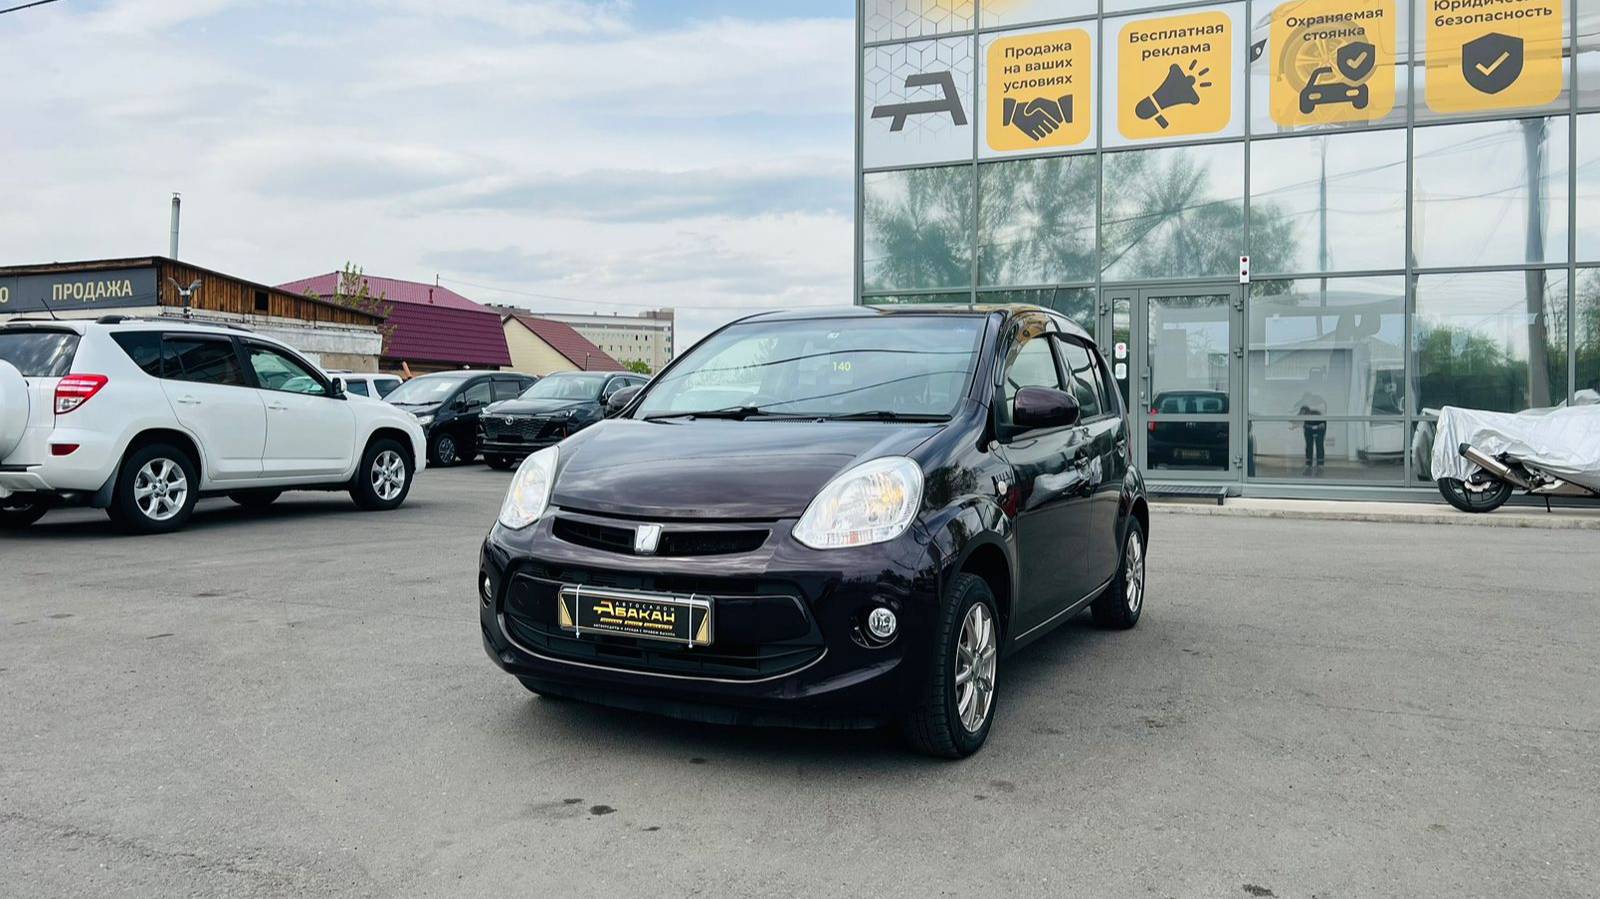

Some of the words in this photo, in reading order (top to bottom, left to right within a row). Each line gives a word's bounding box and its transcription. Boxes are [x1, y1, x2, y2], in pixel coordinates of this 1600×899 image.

[1286, 8, 1384, 28] Охраняемая
[1435, 7, 1553, 27] безопасность
[1129, 24, 1224, 43] Бесплатная
[1303, 26, 1366, 41] стоянка
[1005, 42, 1072, 59] Продажа
[1142, 42, 1211, 61] реклама
[1004, 64, 1021, 75] на
[1025, 58, 1073, 72] ваших
[1003, 75, 1073, 93] условиях
[52, 279, 133, 302] ПРОДАЖА
[832, 360, 851, 372] 140
[615, 601, 675, 612] АВТОСАЛОН
